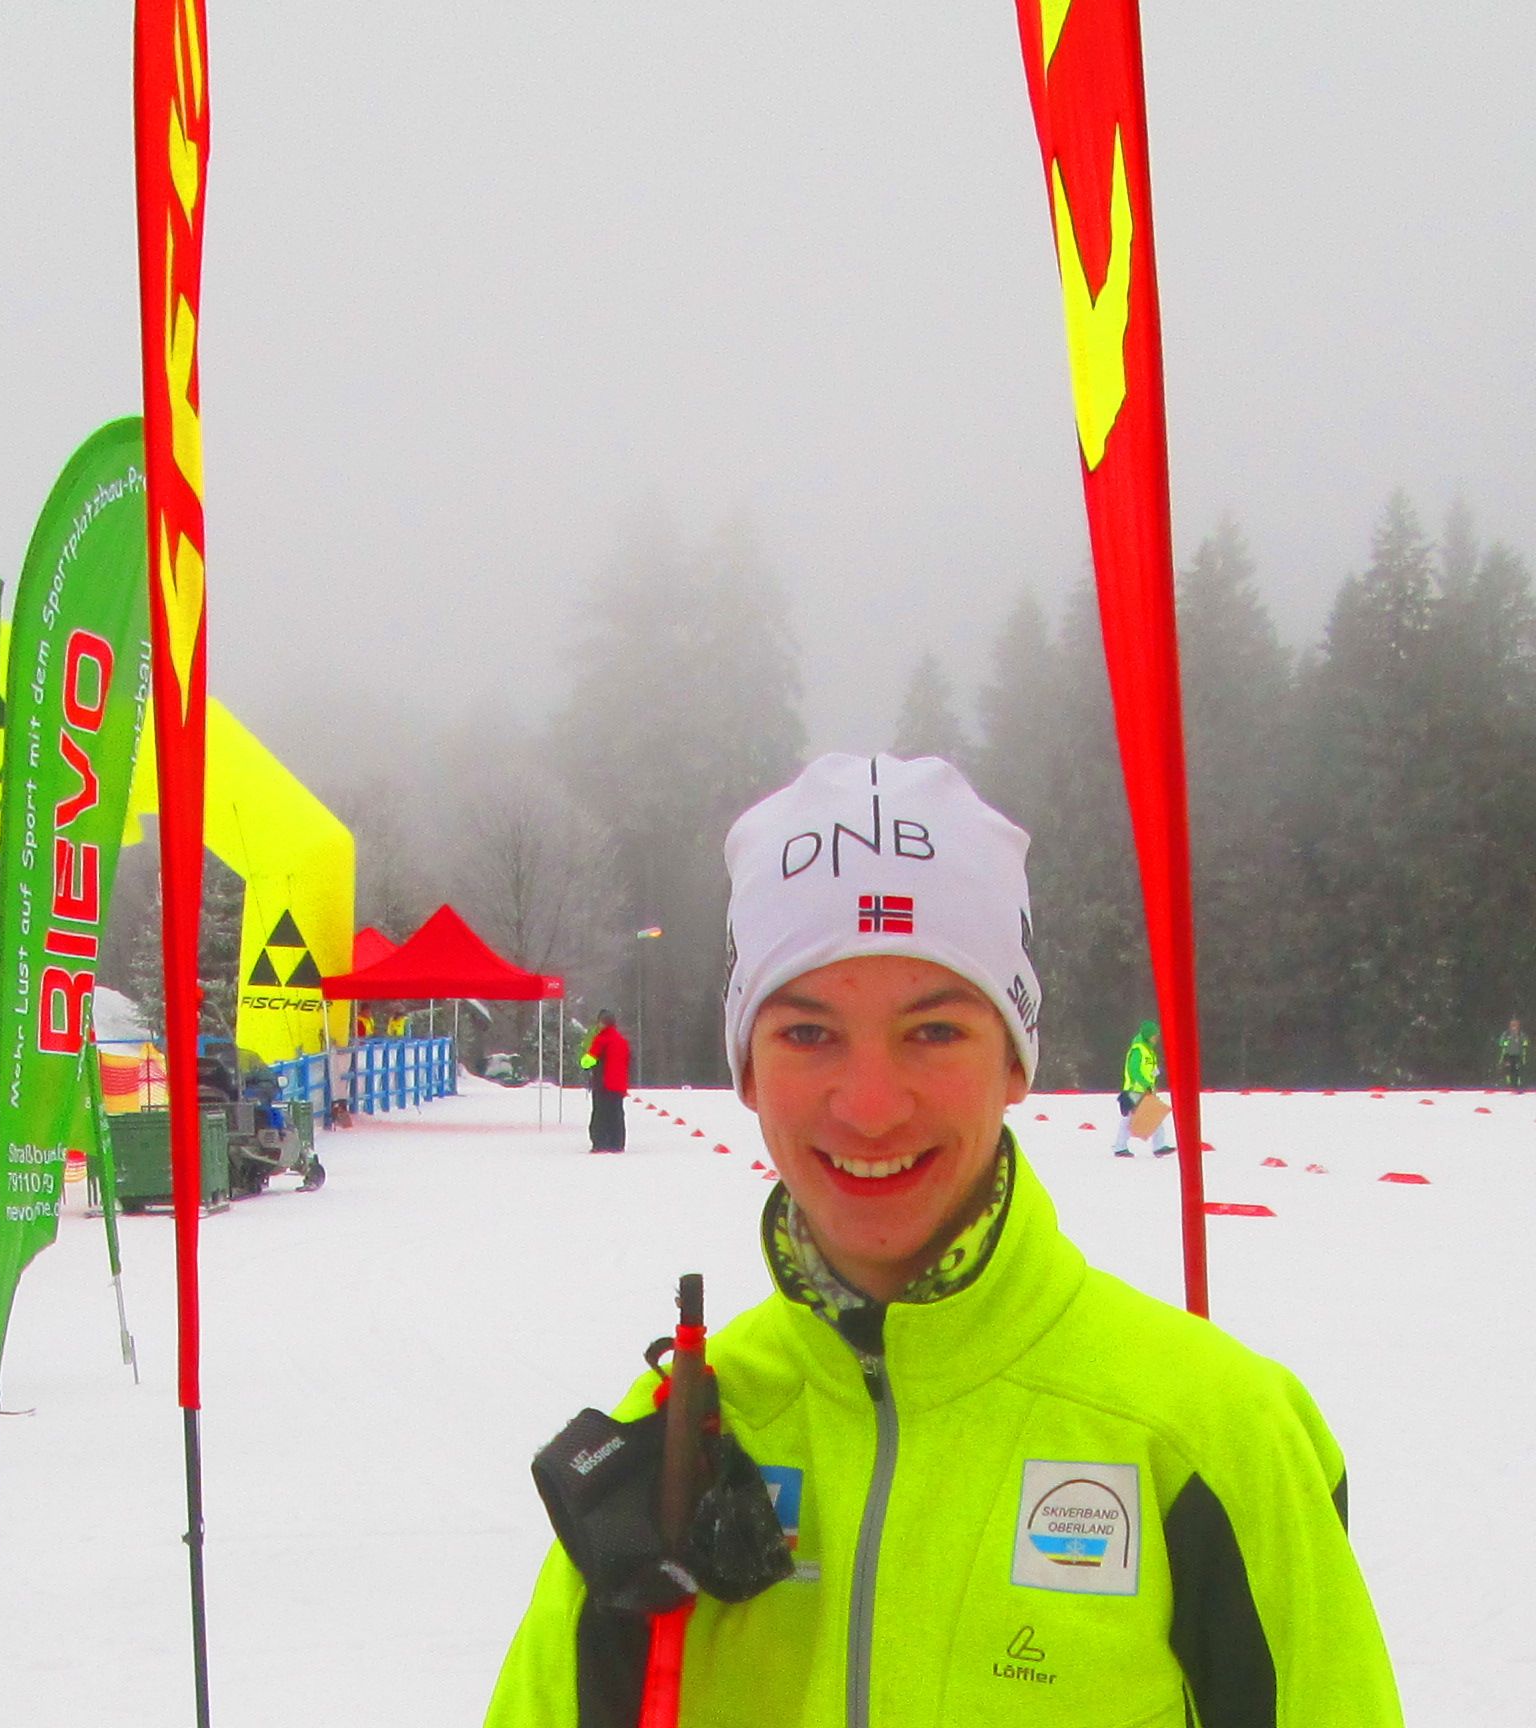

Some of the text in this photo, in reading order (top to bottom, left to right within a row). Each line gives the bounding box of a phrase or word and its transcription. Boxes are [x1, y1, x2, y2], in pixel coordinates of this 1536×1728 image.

[32, 639, 52, 704] dem
[28, 715, 42, 768] mit
[22, 778, 38, 870] Sport
[37, 628, 115, 1056] RIEVO
[20, 882, 33, 934] auf
[14, 946, 31, 1016] Lust
[241, 996, 333, 1014] FISCHER
[10, 1025, 25, 1108] Mehr
[569, 1448, 591, 1470] LEFT
[576, 1436, 626, 1476] ROSSIGNOL
[1041, 1505, 1120, 1520] SKIVERBAND
[1047, 1522, 1115, 1536] OBERLAND
[992, 1662, 1058, 1685] Löffler
